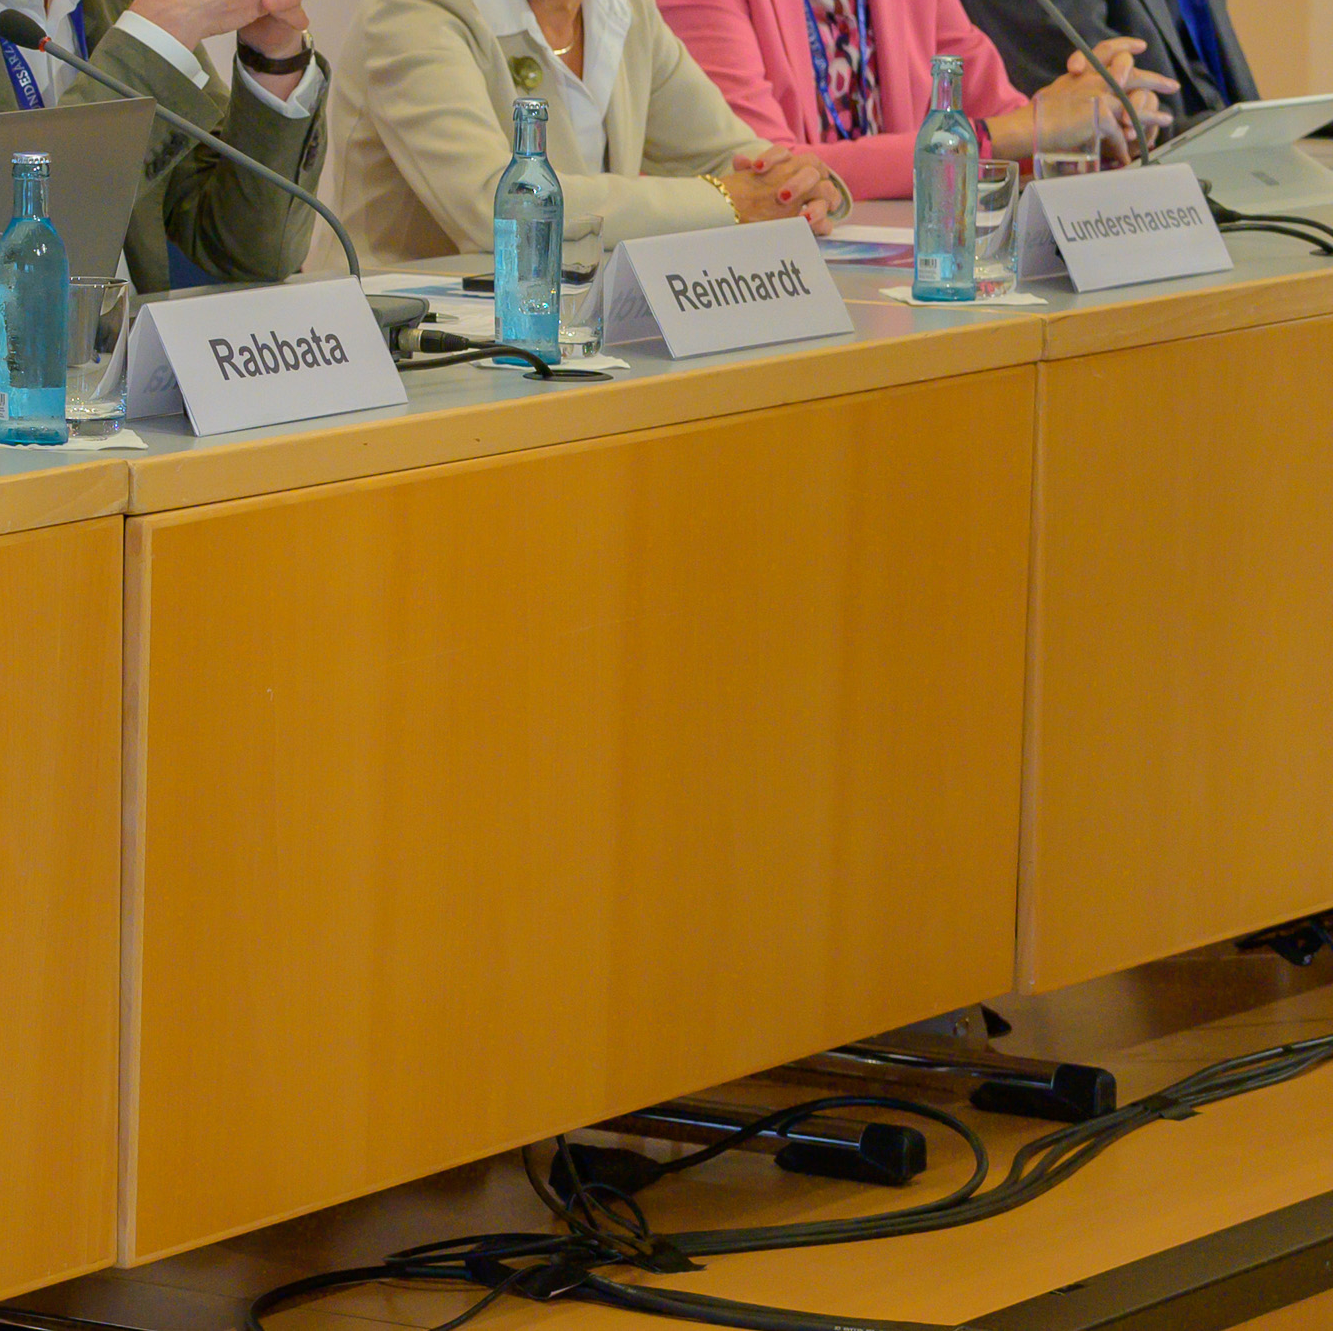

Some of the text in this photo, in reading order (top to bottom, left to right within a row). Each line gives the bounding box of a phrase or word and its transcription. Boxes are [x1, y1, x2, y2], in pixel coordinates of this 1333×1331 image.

[1056, 205, 1204, 243] Lundershausen
[665, 259, 812, 313] Reinhardt
[208, 326, 350, 381] Rabbata
